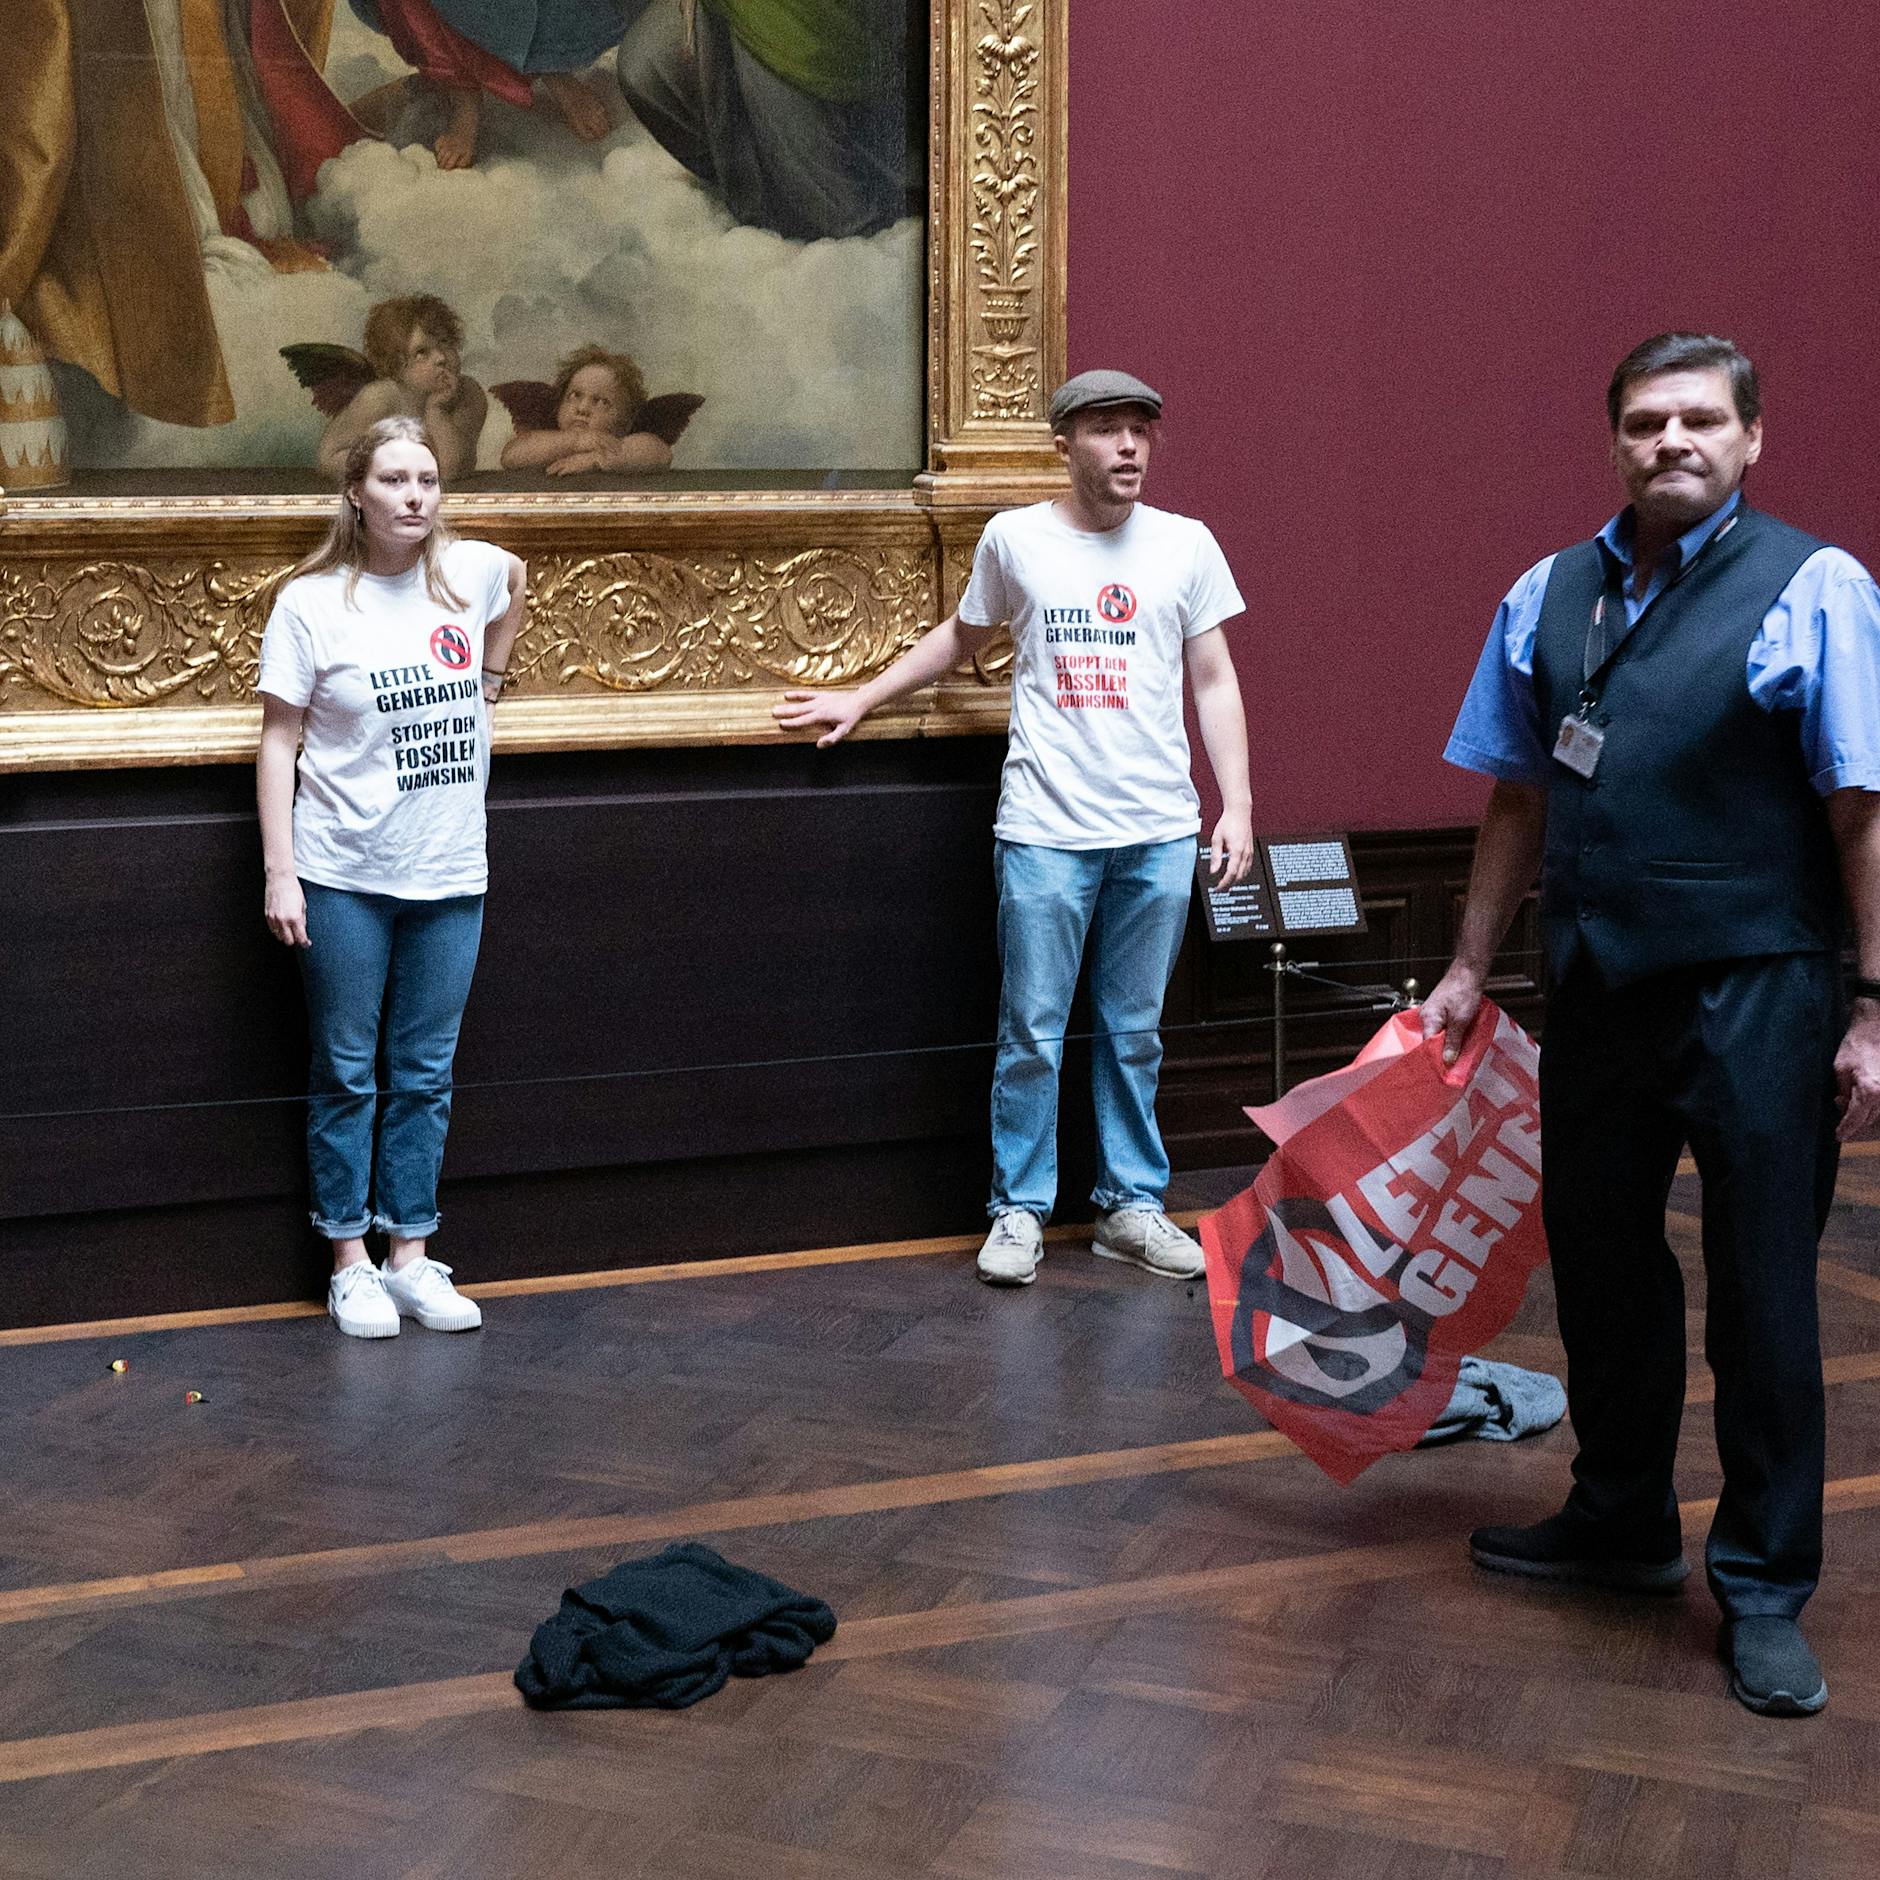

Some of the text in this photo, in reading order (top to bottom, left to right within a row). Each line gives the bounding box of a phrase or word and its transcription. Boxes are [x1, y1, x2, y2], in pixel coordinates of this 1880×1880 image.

[1044, 608, 1092, 624] LETZTE
[1046, 627, 1136, 646] GENERATION
[1054, 655, 1127, 672] STOPPT DEN
[370, 664, 433, 690] LETZTE
[1056, 672, 1127, 692] FOSSILEN
[377, 678, 478, 713] GENERATION
[391, 715, 476, 744] STOPPT DEN
[395, 738, 475, 770] FOSSILEN
